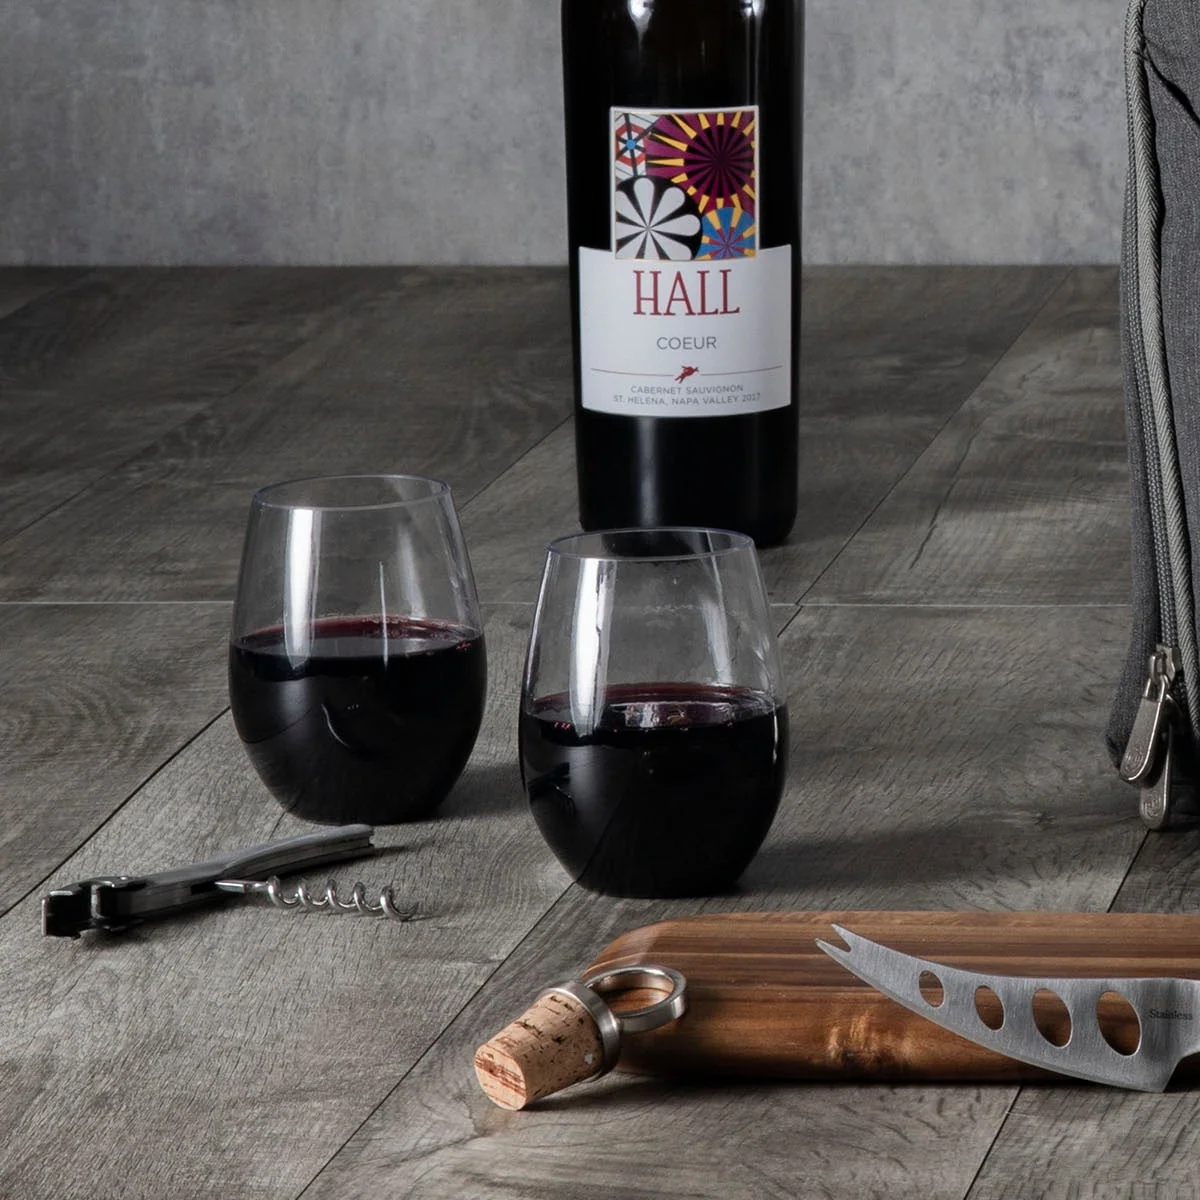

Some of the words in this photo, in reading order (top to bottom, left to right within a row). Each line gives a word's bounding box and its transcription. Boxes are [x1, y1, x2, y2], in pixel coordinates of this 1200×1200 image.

[633, 269, 740, 316] HALL
[656, 336, 717, 350] COEUR
[630, 385, 682, 395] CABERNET
[686, 384, 744, 395] SAUVIGNON
[671, 397, 700, 405] NAPA
[703, 395, 738, 405] VALLEY
[1149, 1008, 1193, 1021] Stainless
